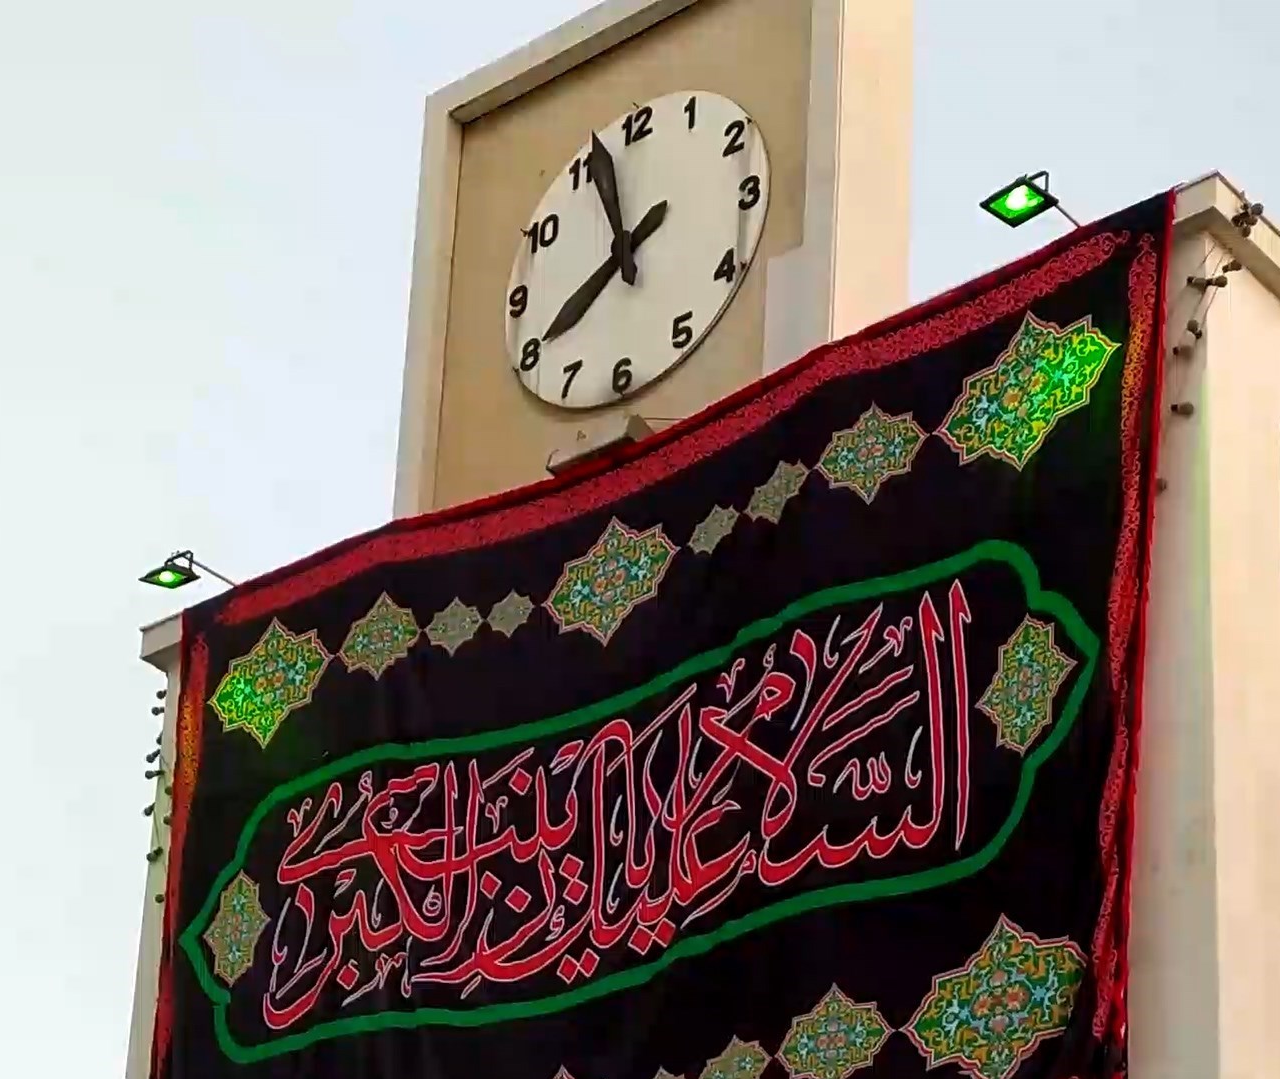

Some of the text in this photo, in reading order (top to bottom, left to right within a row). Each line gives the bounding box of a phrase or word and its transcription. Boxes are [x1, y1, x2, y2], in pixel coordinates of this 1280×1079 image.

[622, 105, 654, 146] 12
[684, 96, 696, 130] 1
[722, 119, 746, 157] 2
[568, 150, 595, 191] 11
[738, 175, 761, 210] 3
[527, 213, 559, 254] 10
[713, 247, 736, 284] 4
[509, 285, 528, 319] 9
[672, 311, 694, 349] 5
[520, 338, 542, 372] 8
[562, 359, 583, 399] 7
[612, 357, 632, 396] 6
